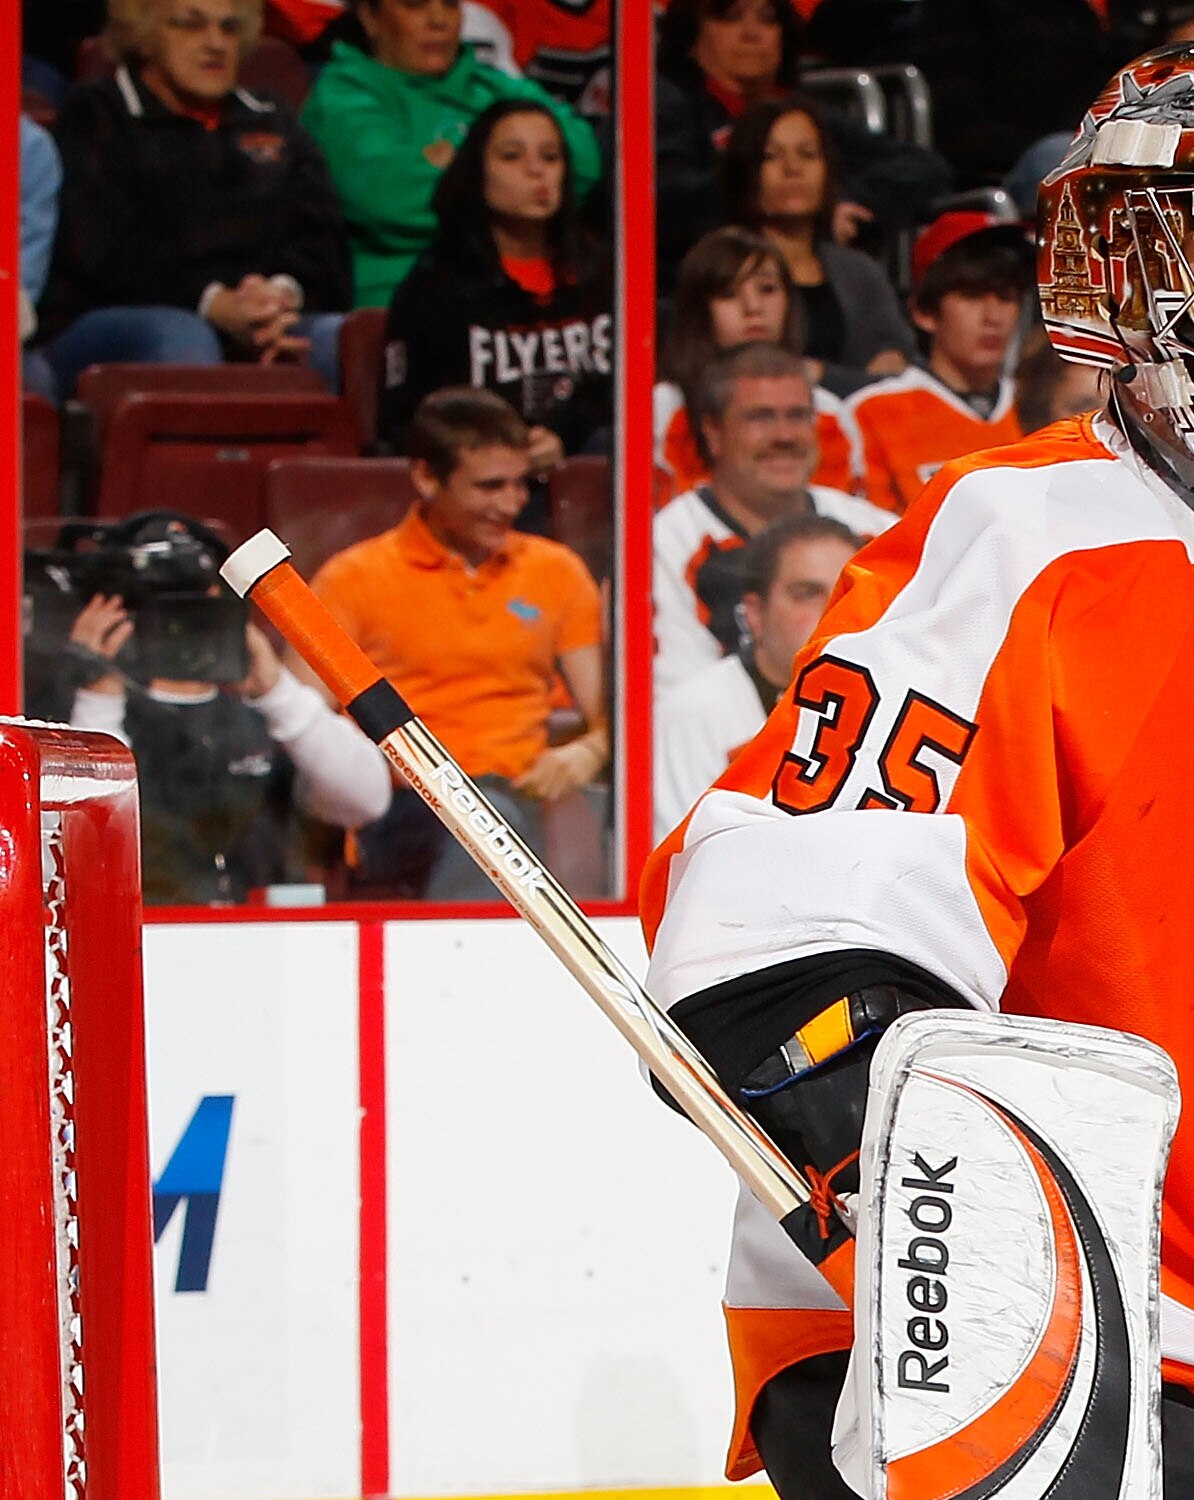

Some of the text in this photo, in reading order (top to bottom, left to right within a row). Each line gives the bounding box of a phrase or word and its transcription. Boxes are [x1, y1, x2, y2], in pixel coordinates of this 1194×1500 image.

[469, 315, 612, 389] FLYERS
[384, 742, 442, 812] Reebok
[771, 653, 979, 816] 35
[429, 760, 550, 900] Reebok
[897, 1151, 959, 1393] Reebok
